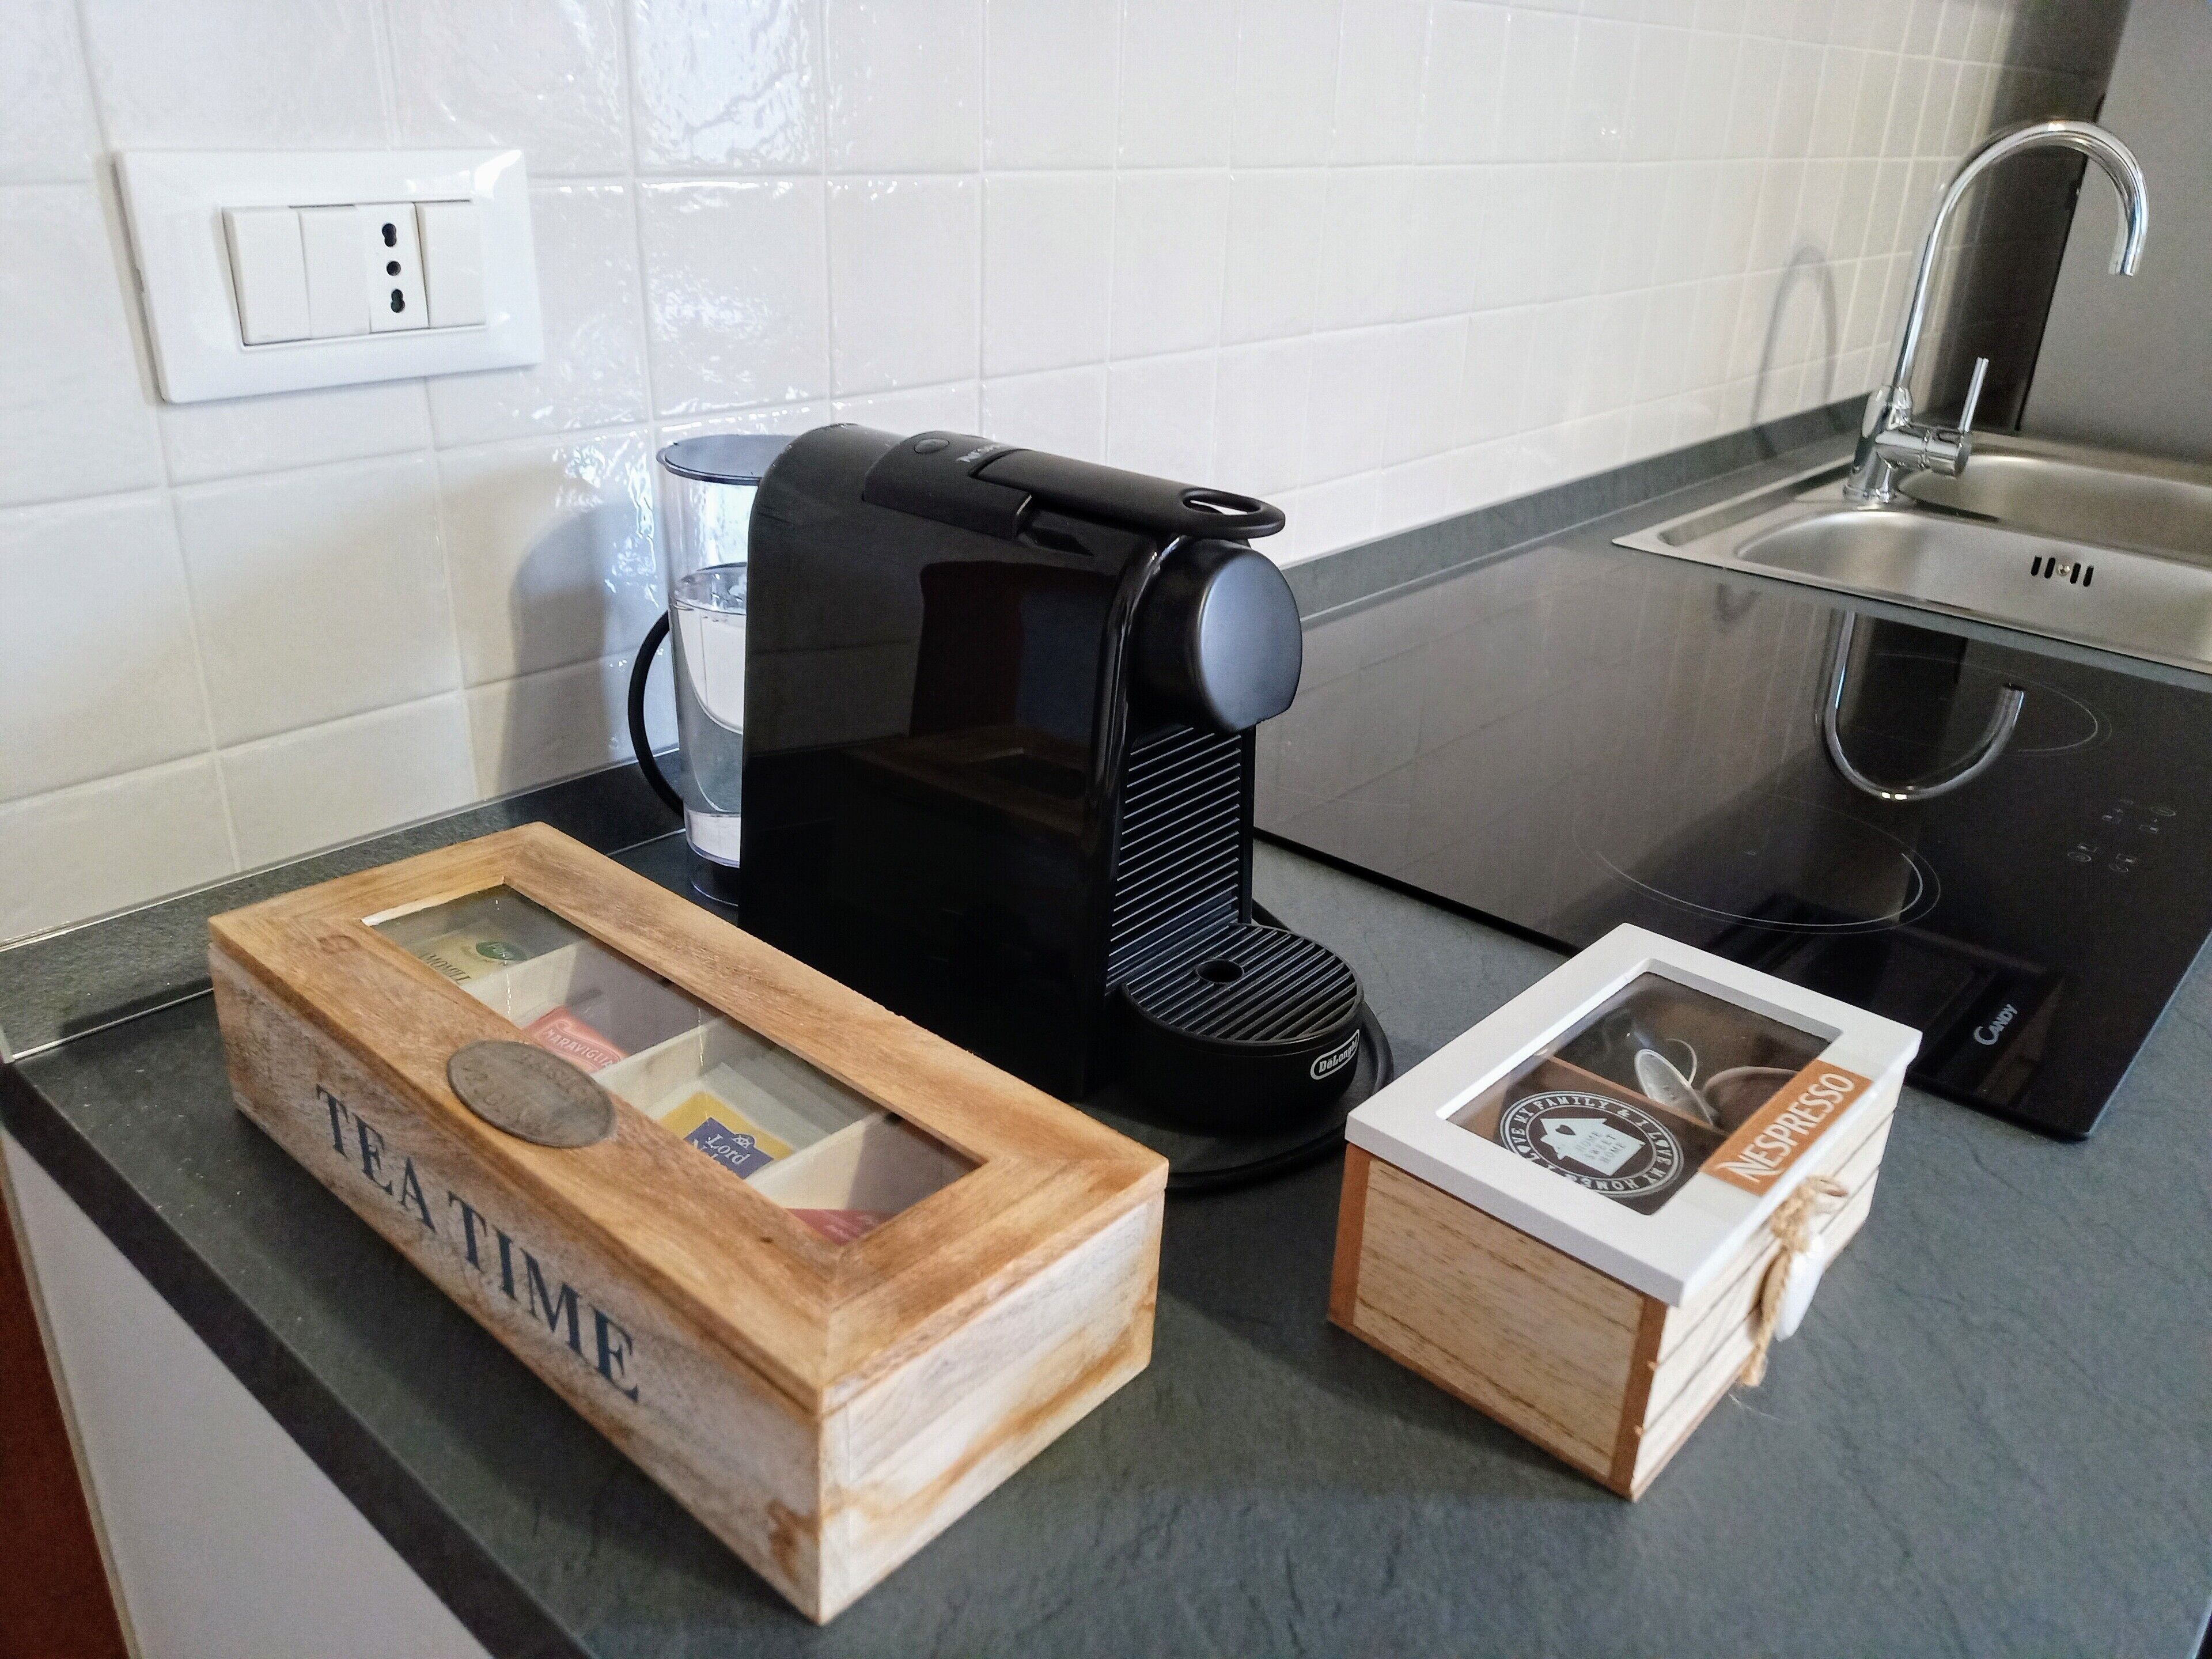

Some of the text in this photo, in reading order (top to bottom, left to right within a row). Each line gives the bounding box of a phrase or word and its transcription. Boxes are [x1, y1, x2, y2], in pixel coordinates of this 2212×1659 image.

[1973, 1003, 2018, 1046] CANDY
[706, 1134, 751, 1165] Lord
[1514, 1108, 1535, 1124] MY
[1532, 1097, 1609, 1110] FAMILY
[1642, 1167, 1667, 1184] MY
[1714, 1073, 1856, 1184] NESPRESSO
[316, 1084, 435, 1233] TEA
[448, 1190, 639, 1404] TIME
